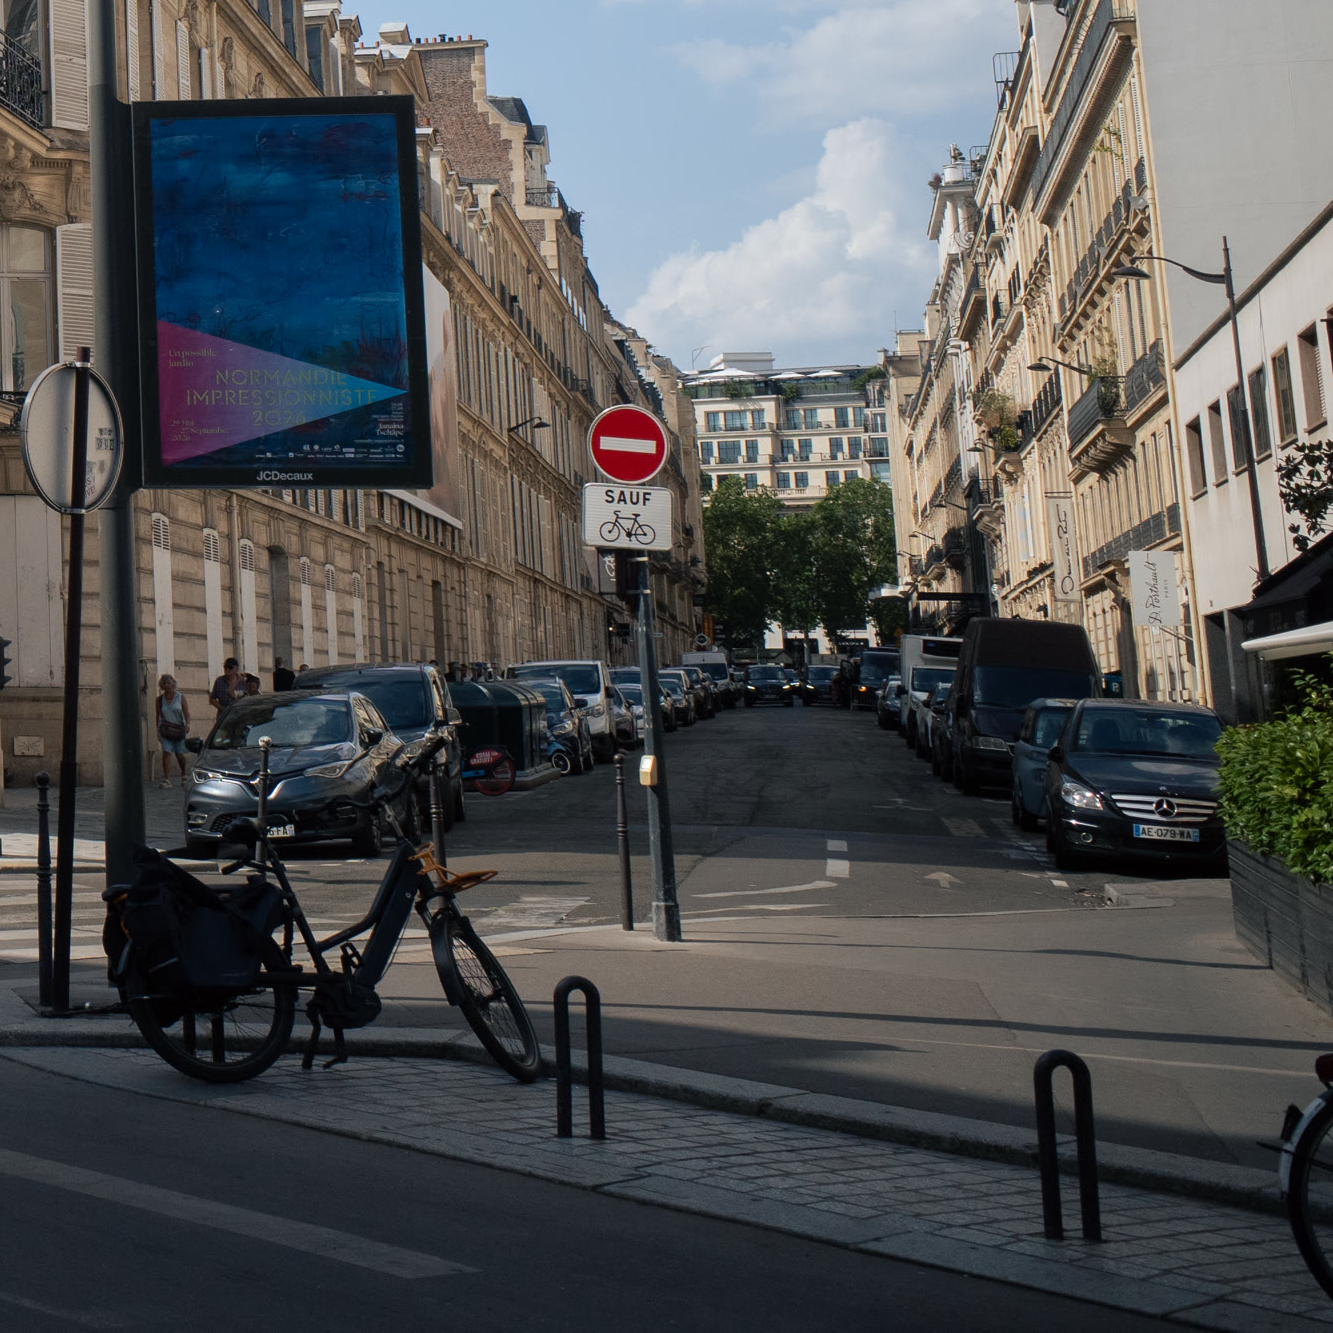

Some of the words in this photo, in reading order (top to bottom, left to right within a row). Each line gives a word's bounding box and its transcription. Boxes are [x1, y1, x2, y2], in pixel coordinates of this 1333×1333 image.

[181, 348, 217, 359] possible
[168, 359, 194, 370] jardin
[216, 369, 347, 385] NORMANDIE
[186, 389, 378, 407] IMPRESSIONNISTE
[252, 410, 306, 427] 2026
[256, 470, 313, 481] JCDecaux
[605, 489, 651, 506] SAUF
[1144, 553, 1161, 609] Porthault
[1141, 827, 1192, 840] AE-079-WA
